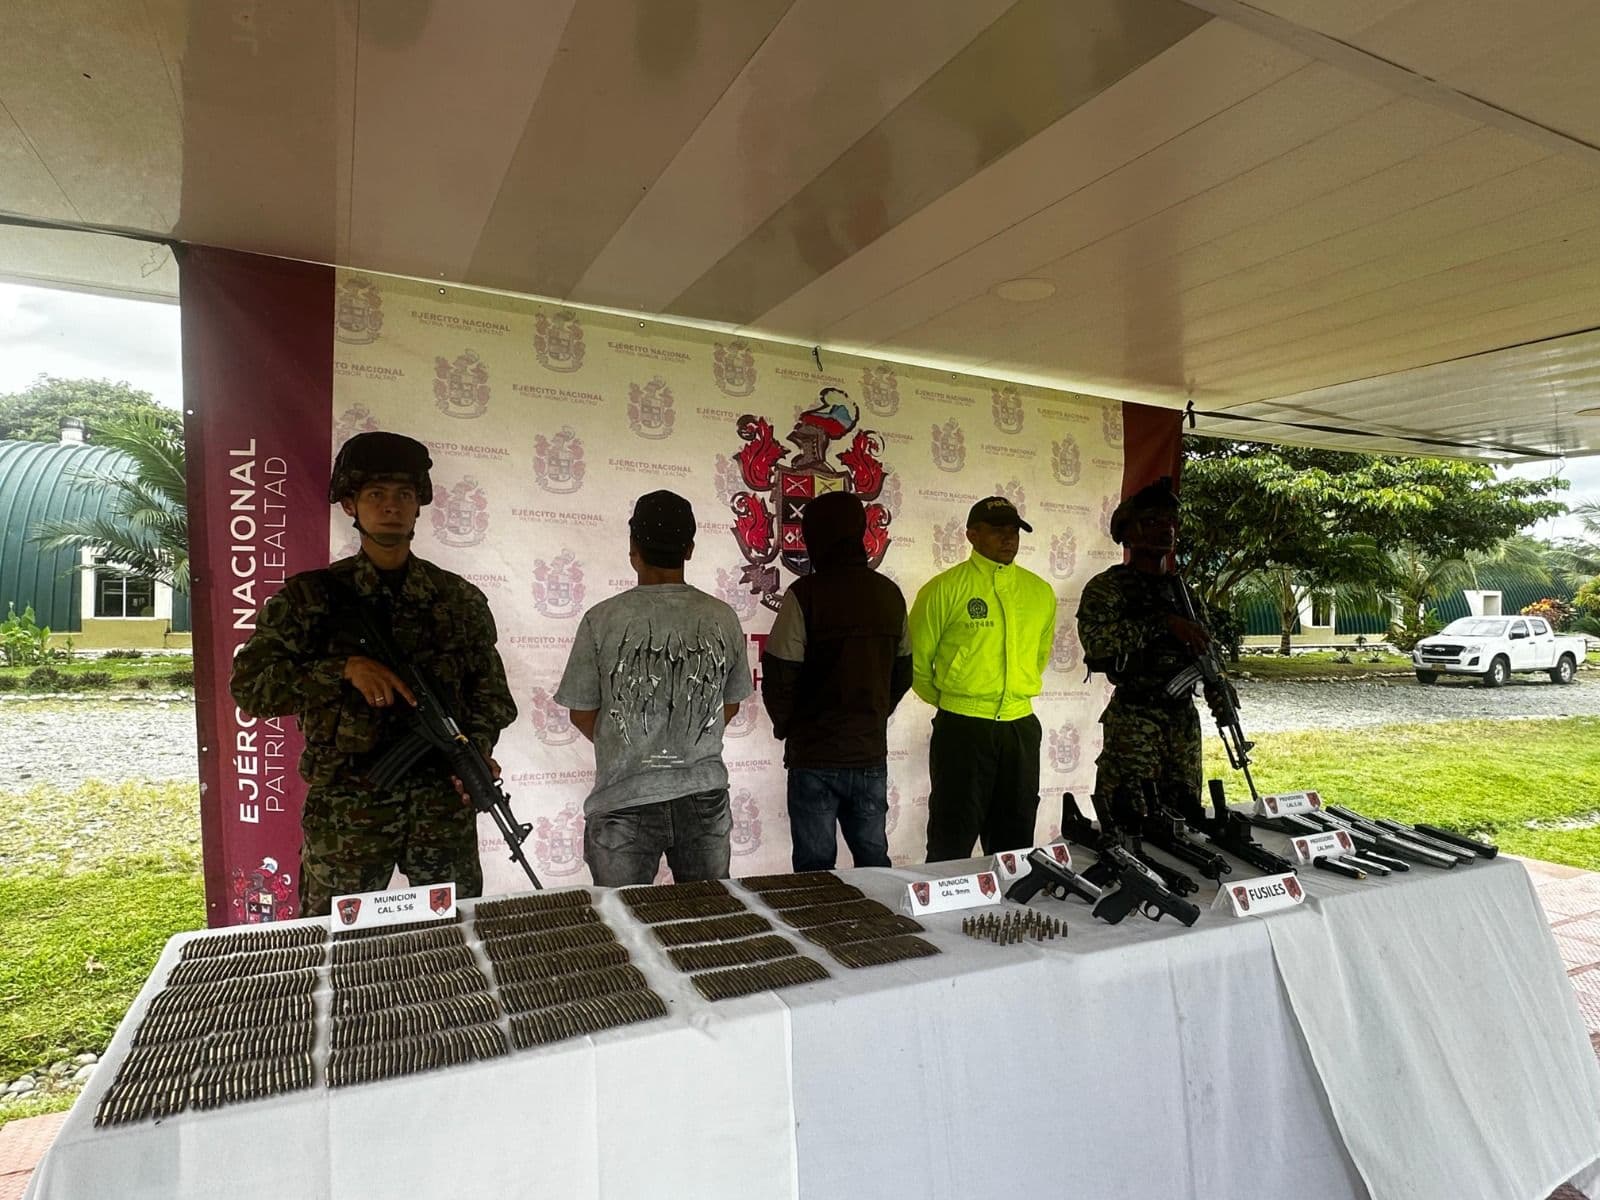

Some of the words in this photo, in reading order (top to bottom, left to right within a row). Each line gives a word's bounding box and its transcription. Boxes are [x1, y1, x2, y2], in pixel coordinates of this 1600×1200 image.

[462, 319, 512, 333] NACIONAL
[650, 347, 692, 361] NACIONAL
[351, 362, 406, 377] NACIONAL
[559, 389, 605, 402] NACIONAL
[460, 444, 511, 456] NACIONAL
[651, 463, 692, 474] NACIONAL
[263, 456, 288, 584] LEALTAD
[558, 511, 604, 522] NACIONAL
[229, 438, 257, 630] NACIONAL
[735, 759, 771, 768] NACIONAL
[559, 768, 593, 779] NACION
[938, 878, 969, 888] MUNICION
[374, 892, 417, 905] MUNICION
[1248, 883, 1286, 901] FUSILES
[377, 906, 395, 915] CAL.
[396, 903, 414, 912] 5.56
